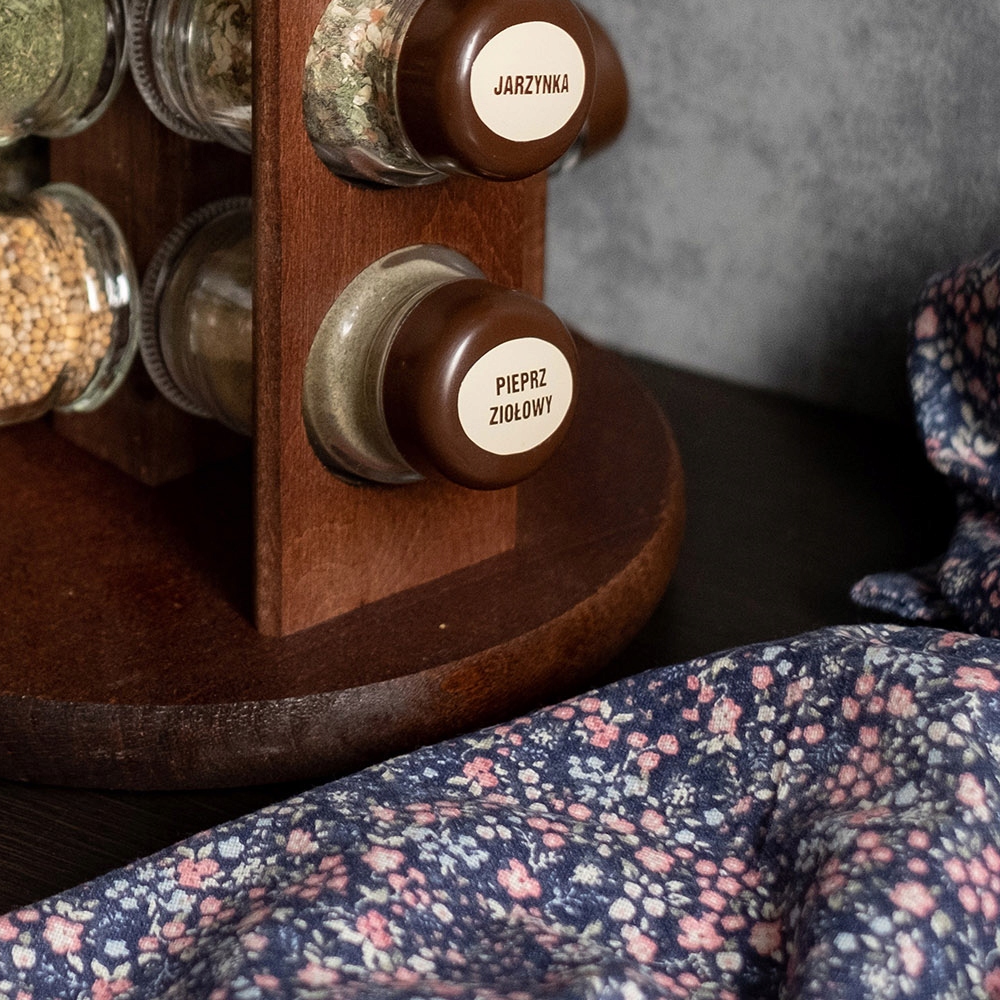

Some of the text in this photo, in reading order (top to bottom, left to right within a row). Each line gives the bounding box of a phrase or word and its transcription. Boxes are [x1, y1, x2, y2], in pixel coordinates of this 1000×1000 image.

[494, 74, 569, 96] JARZYNKA
[496, 368, 547, 396] PIEPRZ
[489, 396, 553, 426] ZIOŁOWY
